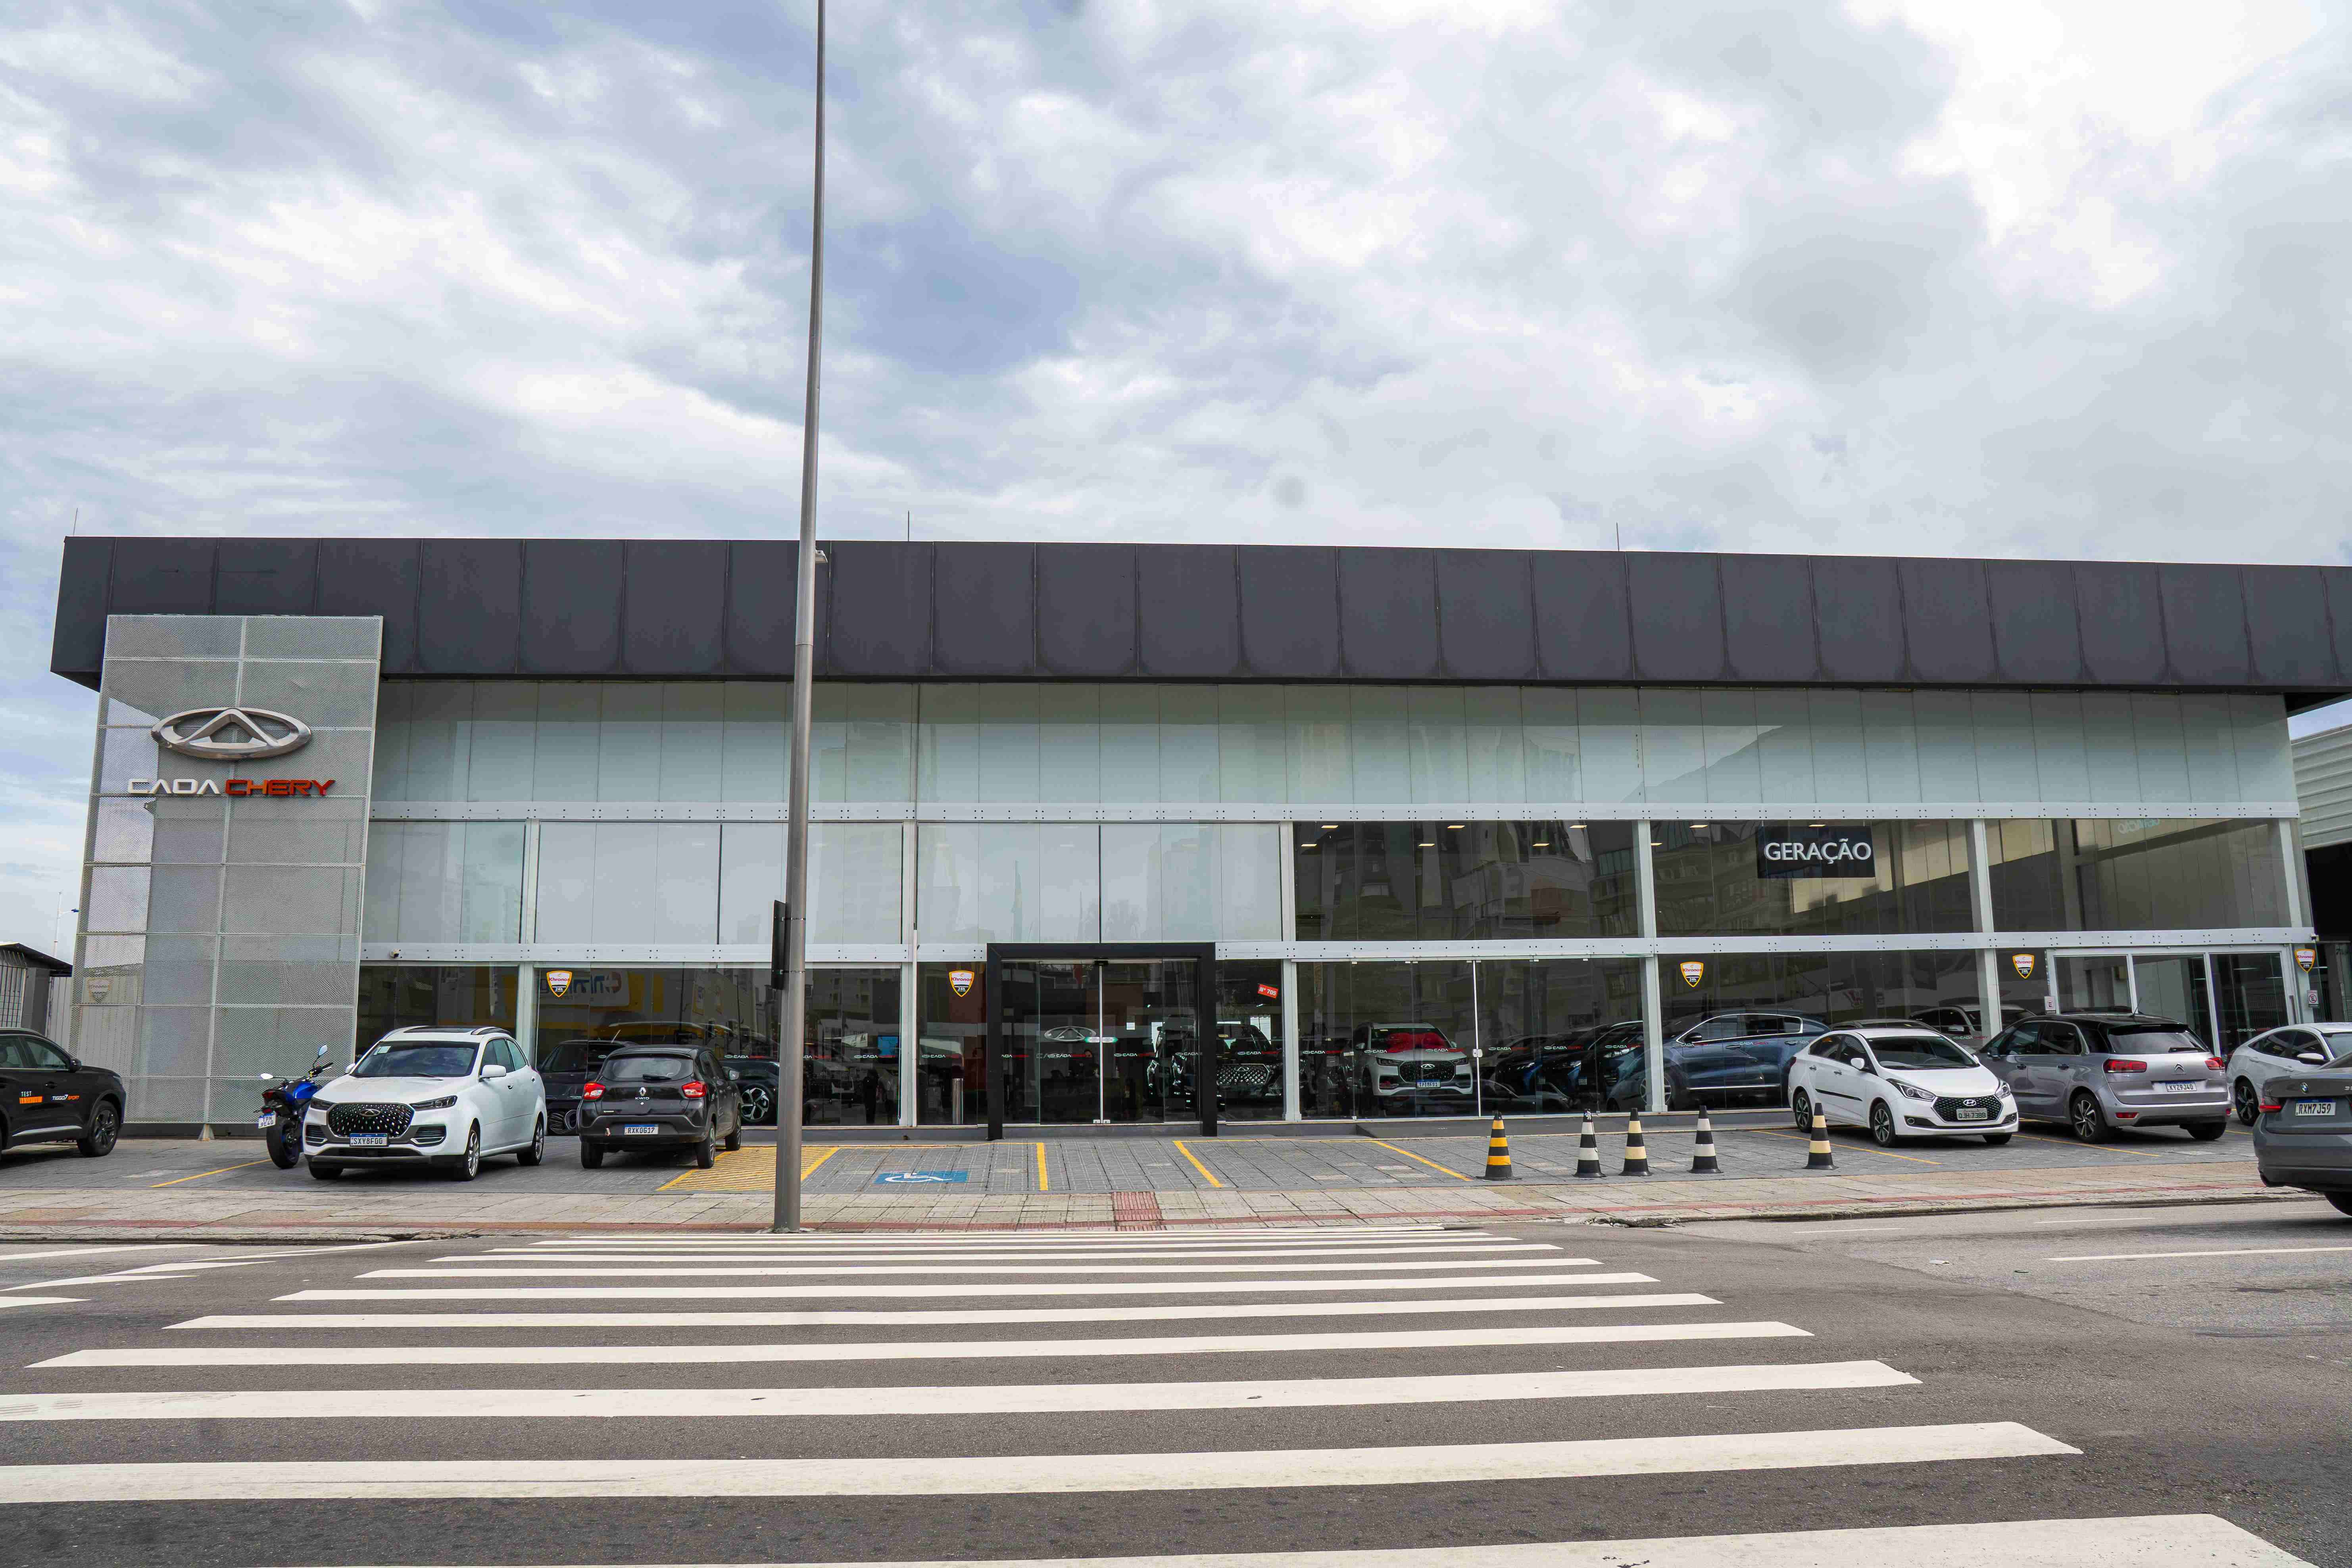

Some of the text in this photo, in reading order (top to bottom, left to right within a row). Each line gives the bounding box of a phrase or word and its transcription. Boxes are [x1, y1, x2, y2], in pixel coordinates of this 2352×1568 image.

[225, 779, 336, 796] CHERY
[1764, 838, 1872, 864] GERAÇÃO
[2298, 1104, 2331, 1114] RXM7J59
